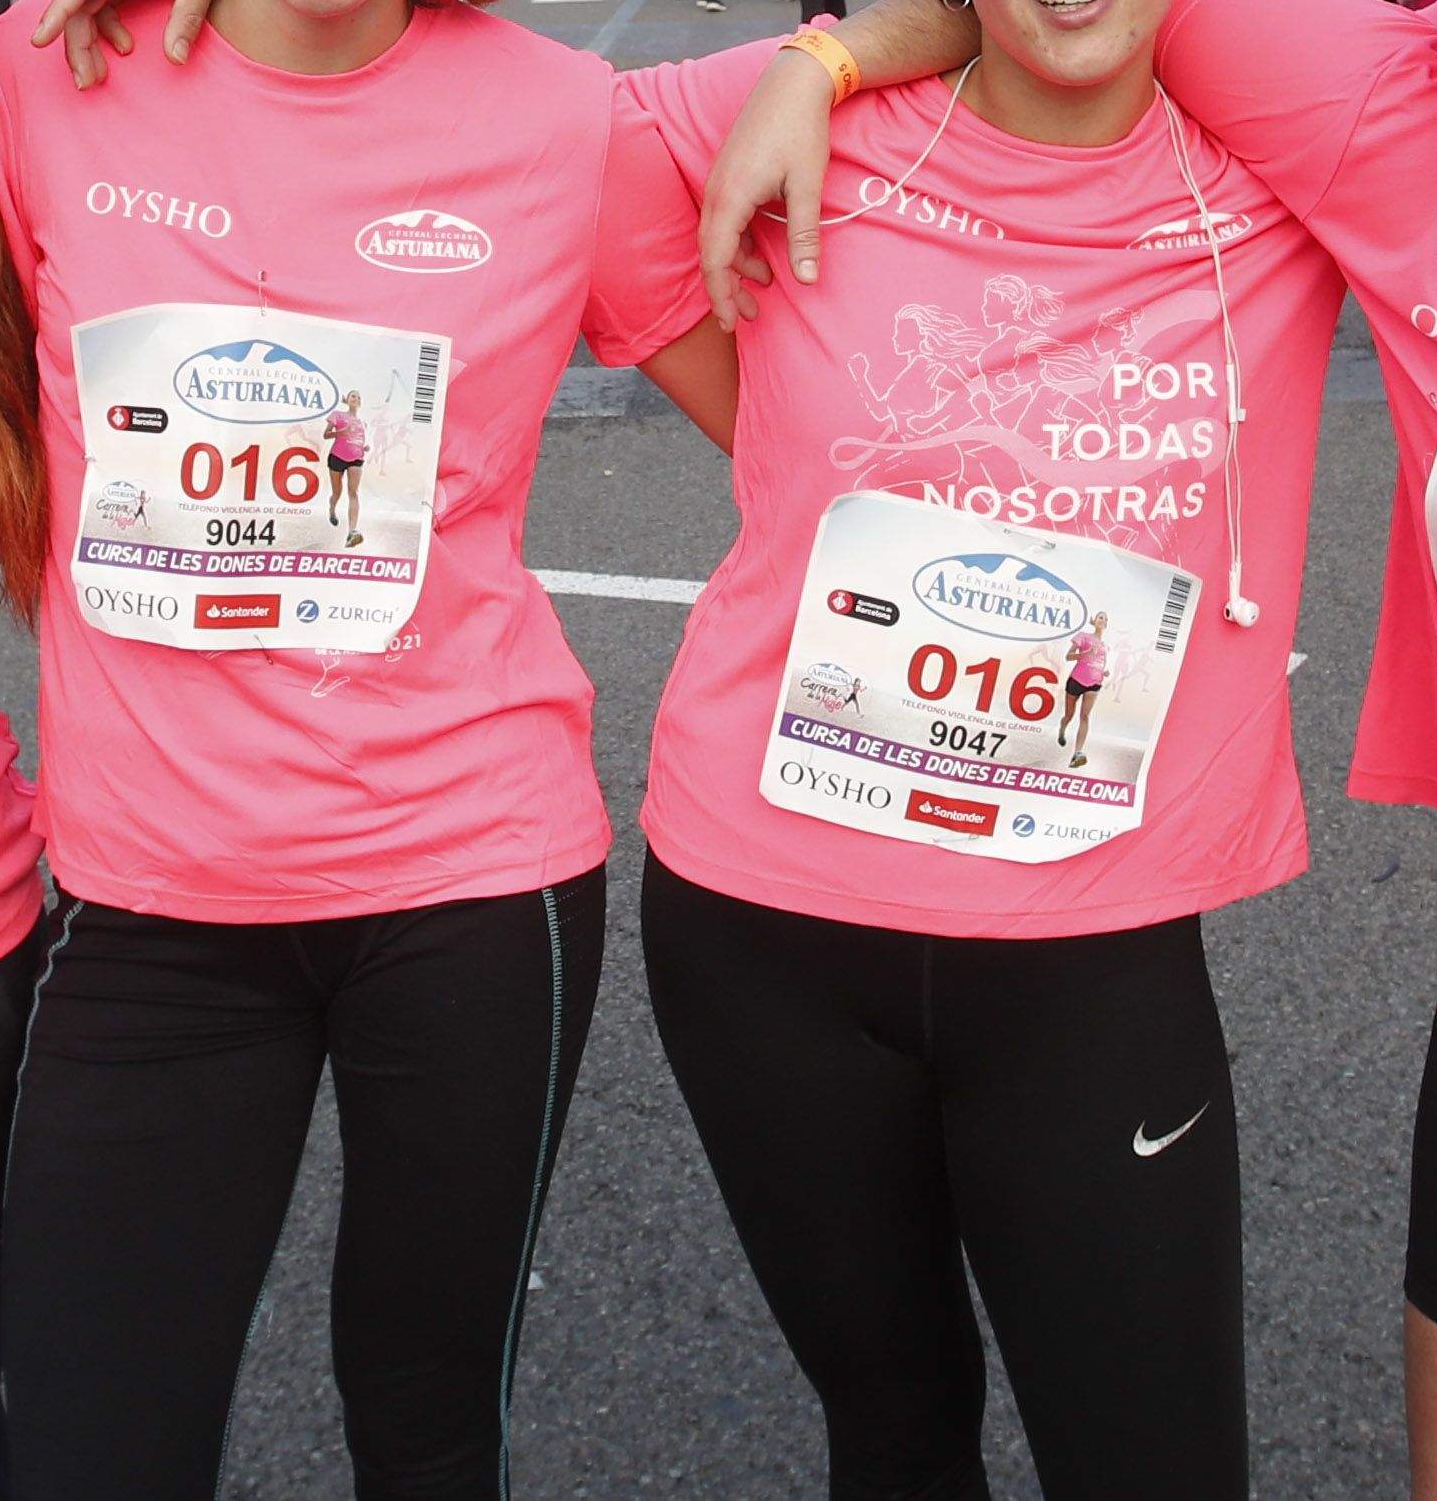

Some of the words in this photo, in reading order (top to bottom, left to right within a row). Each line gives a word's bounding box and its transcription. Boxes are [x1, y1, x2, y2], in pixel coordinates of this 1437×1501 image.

[86, 181, 232, 239] OYSHO
[365, 230, 482, 260] ASTURIANA
[185, 367, 325, 411] ASTURIANA
[208, 366, 262, 377] CENTRAL
[1112, 362, 1218, 400] POR
[1042, 421, 1216, 464] TODAS
[180, 442, 321, 504] 016
[923, 481, 1207, 525] NOSOTRAS
[206, 518, 276, 547] 9044
[87, 542, 142, 565] CURSA
[146, 547, 166, 567] DE
[170, 550, 202, 572] LES
[206, 554, 265, 573] DONES
[269, 556, 293, 573] DE
[298, 556, 411, 580] BARCELONA
[925, 570, 1072, 630] ASTURIANA
[955, 572, 1011, 593] CENTRAL
[85, 586, 179, 621] OYSHO
[221, 605, 270, 618] Santander
[328, 605, 394, 624] ZURICH
[907, 643, 1059, 721] 016
[928, 720, 1007, 758] 9047
[948, 709, 995, 726] VIOLENCIA
[996, 720, 1007, 729] DE
[789, 718, 851, 750] CURSA
[855, 734, 883, 757] DE
[885, 743, 922, 768] LES
[924, 752, 989, 784] DONES
[992, 766, 1019, 786] DE
[1021, 771, 1130, 804] BARCELONA
[779, 760, 892, 811] OYSHO
[932, 804, 986, 825] Santander
[1044, 823, 1112, 842] ZURICH
